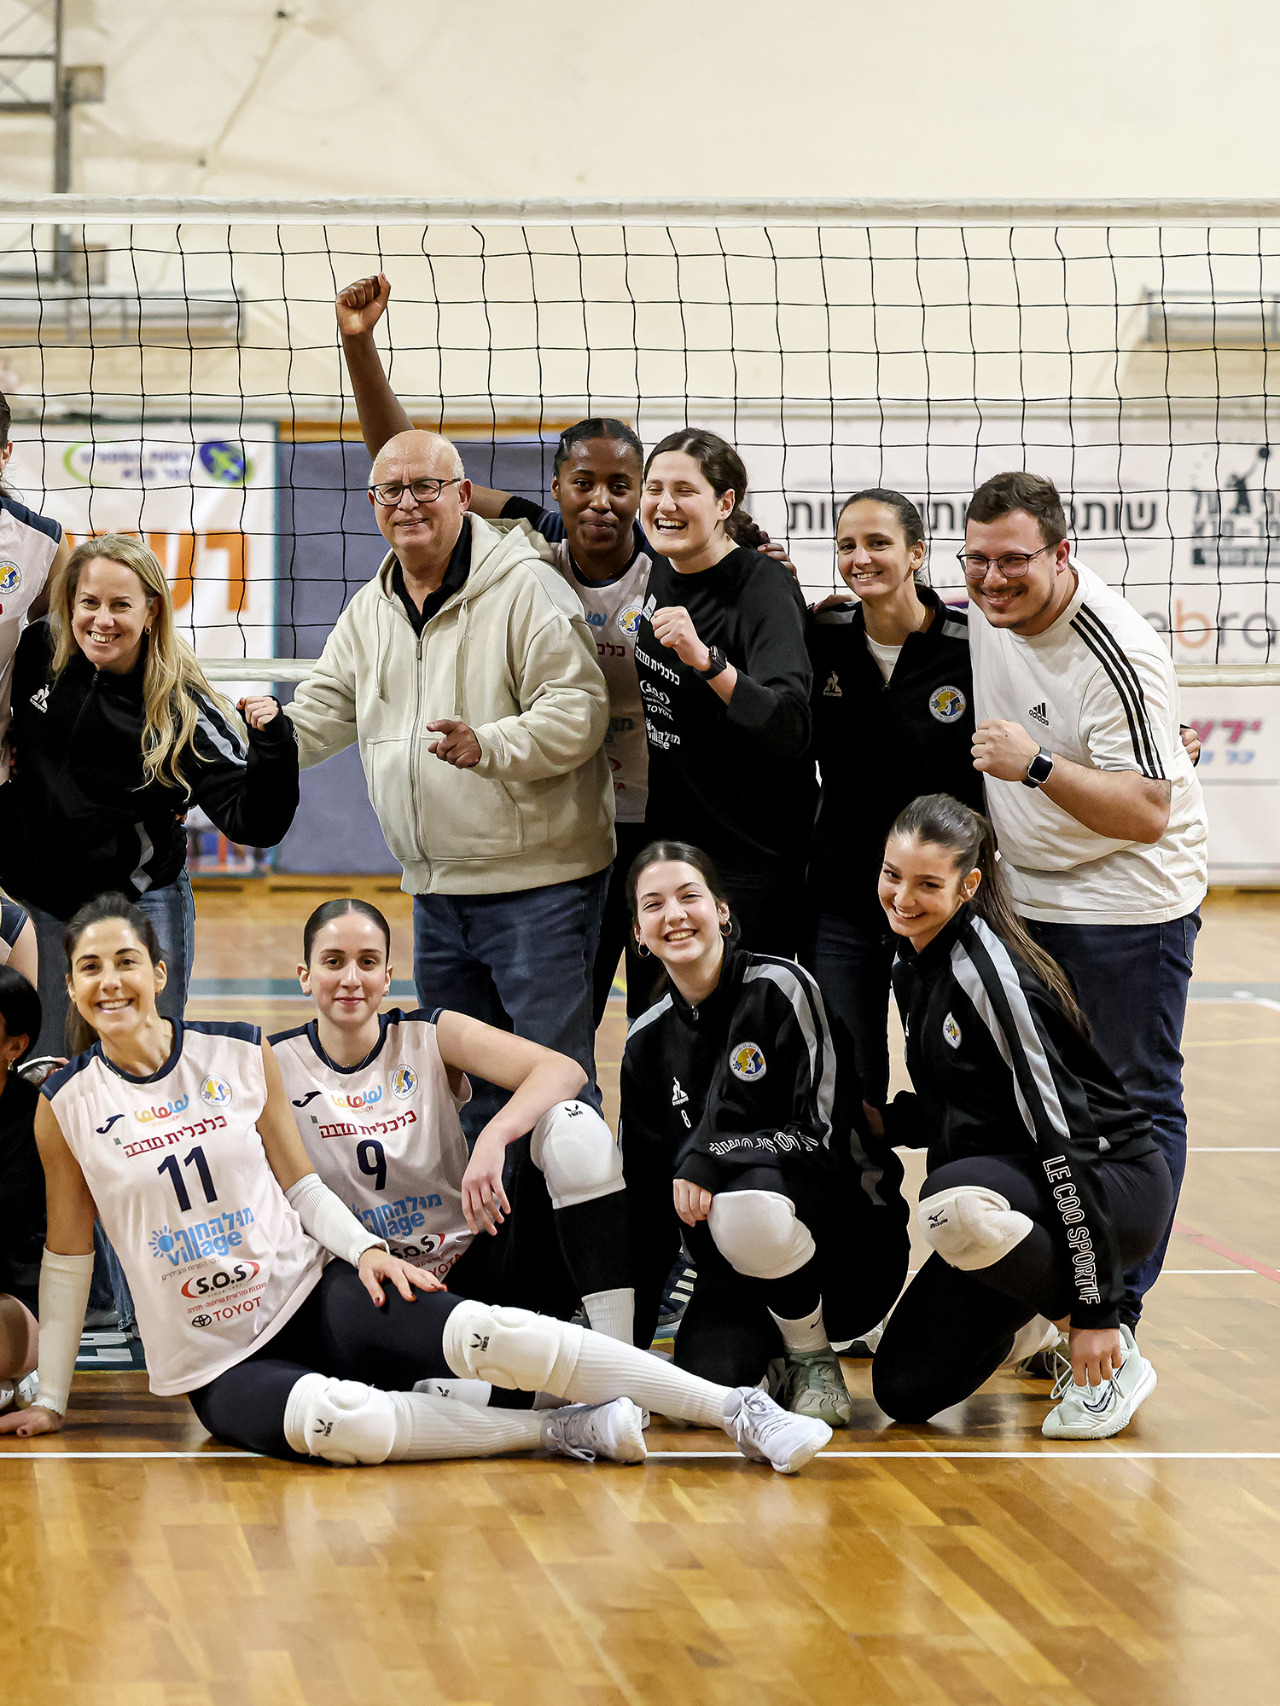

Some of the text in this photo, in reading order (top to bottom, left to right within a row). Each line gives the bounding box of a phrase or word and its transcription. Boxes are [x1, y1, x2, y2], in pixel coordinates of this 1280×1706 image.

[596, 641, 626, 658] כלכ
[1029, 709, 1049, 726] adidas
[319, 1109, 417, 1138] כלכלית חדרה
[680, 1109, 692, 1129] 8
[123, 1115, 228, 1158] כלכלית חדרה
[157, 1145, 218, 1212] 11
[356, 1139, 387, 1190] 9
[370, 1210, 425, 1238] llage
[1042, 1154, 1101, 1305] LE COQ SPORTIF
[167, 1230, 243, 1266] village
[428, 1253, 462, 1276] YOTA
[196, 1264, 247, 1295] S.O.S
[213, 1296, 262, 1322] TOYOT
